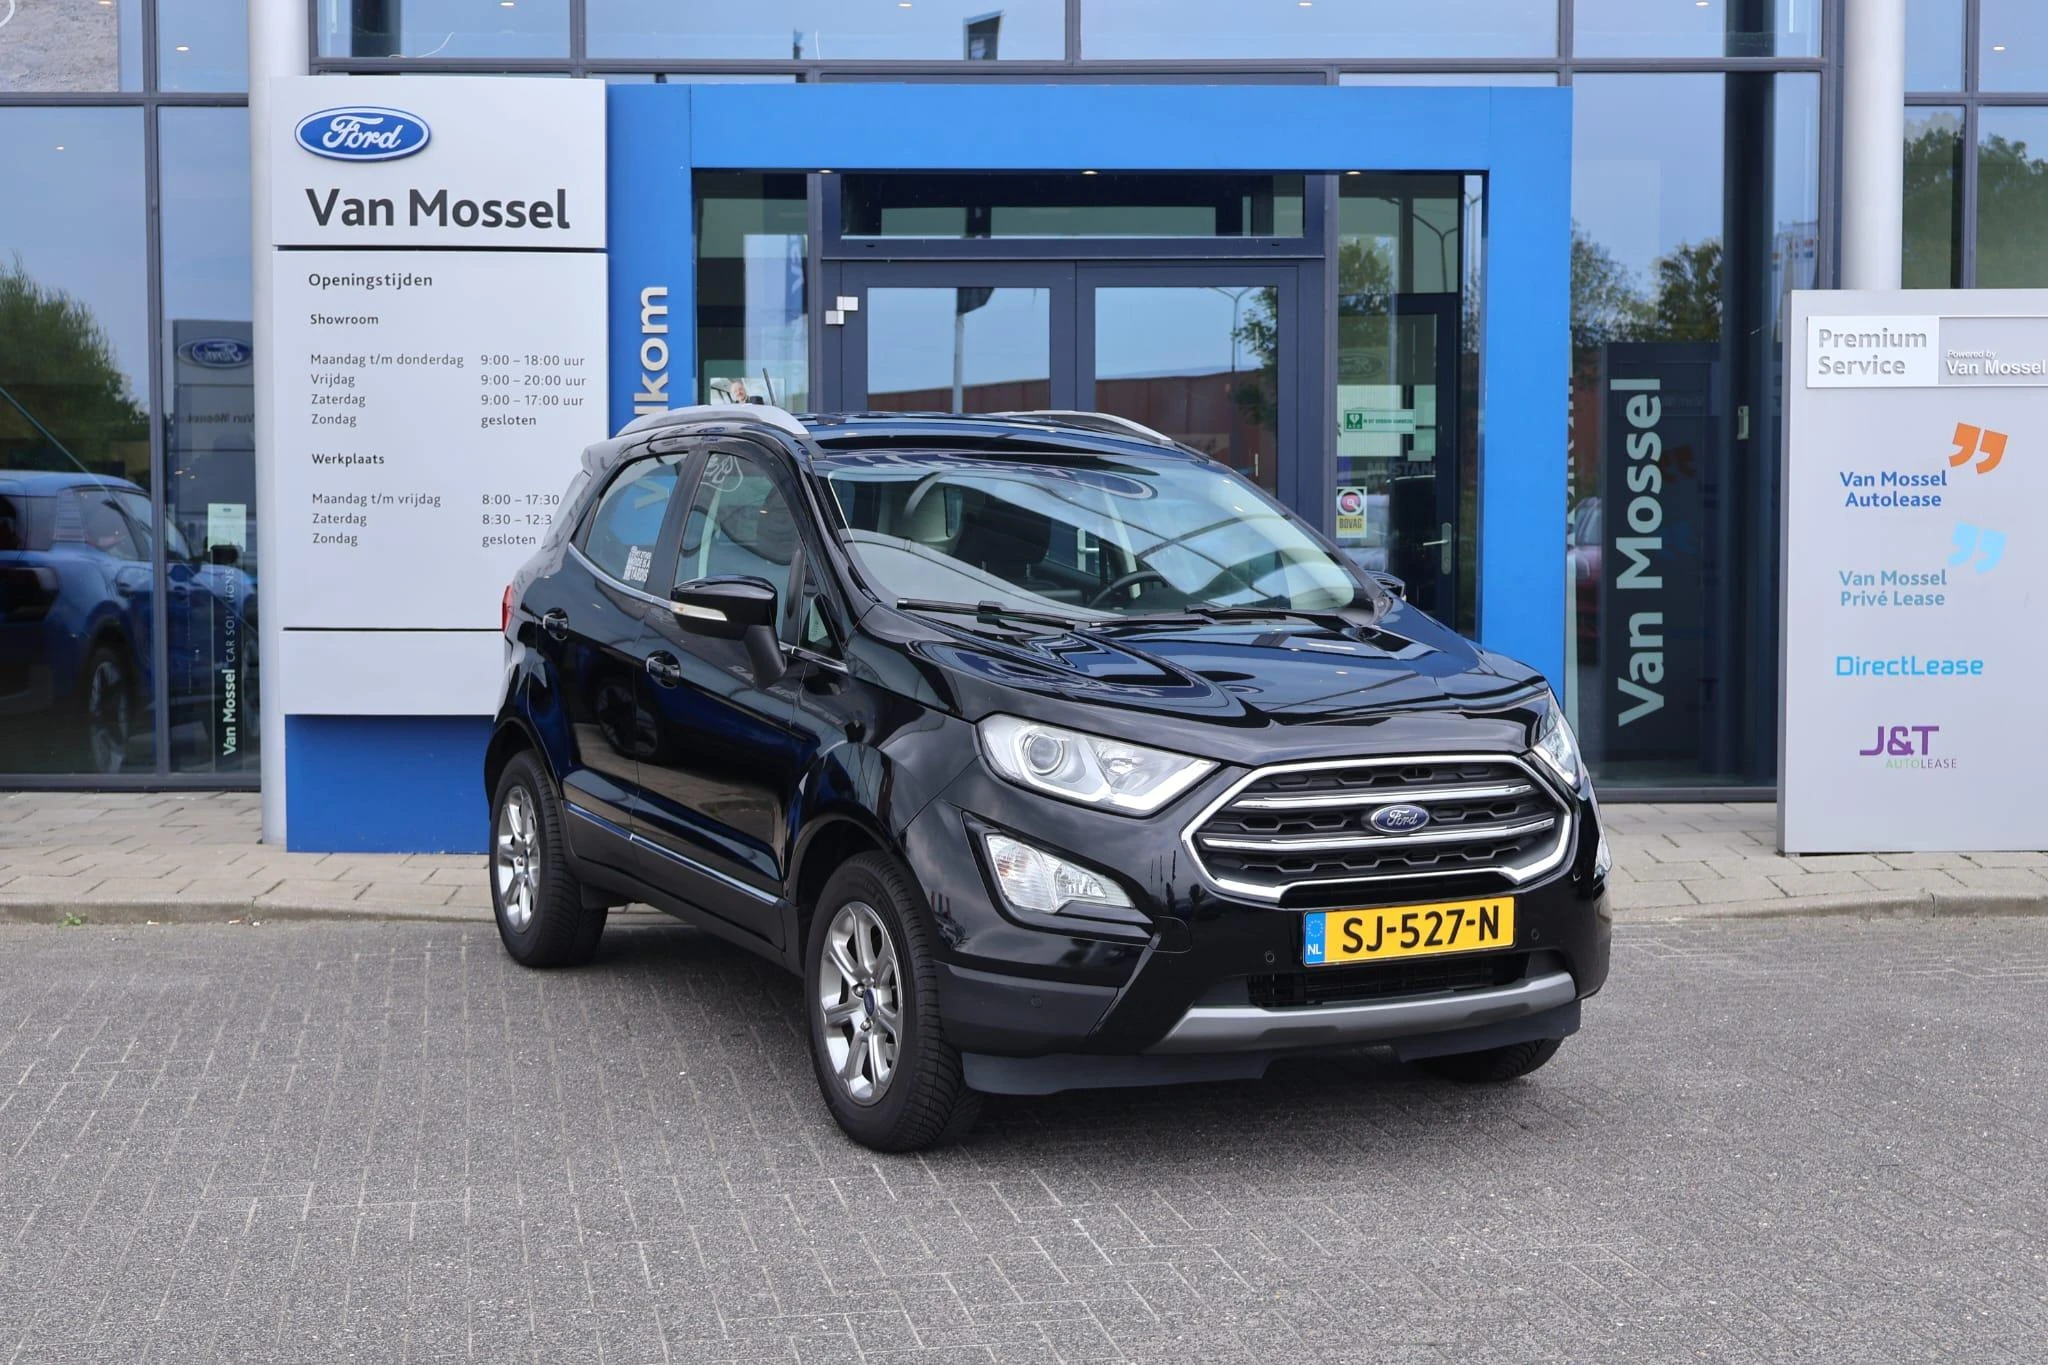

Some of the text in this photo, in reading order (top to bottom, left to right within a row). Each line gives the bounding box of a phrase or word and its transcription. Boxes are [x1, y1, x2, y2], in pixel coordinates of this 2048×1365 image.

[322, 115, 403, 149] Ford
[305, 188, 571, 229] Van Mossel
[308, 273, 433, 290] Openingstijden
[310, 313, 379, 326] Showroom
[1818, 327, 1927, 348] Premium
[634, 286, 670, 416] lkom
[1947, 349, 1997, 360] Powered by
[311, 353, 464, 369] Maandag t/m donderdag
[481, 354, 510, 366] 9:00
[524, 354, 560, 366] 18:00
[564, 357, 585, 367] uur
[1818, 354, 1906, 375] Service
[1946, 359, 2046, 376] Van Mossel
[311, 373, 355, 388] Vrijdag
[481, 375, 510, 386] 9:00
[524, 375, 562, 386] 20:00
[565, 377, 587, 387] uur
[311, 393, 366, 408] Zaterdag
[481, 394, 510, 406] 9:00
[525, 395, 560, 406] 17:00
[563, 397, 584, 407] uur
[312, 413, 357, 428] Zondag
[481, 414, 537, 429] gesloten
[312, 452, 385, 468] Werkplaats
[1839, 470, 1948, 488] Van Mossel
[312, 492, 442, 509] Maandag t/m vrijdag
[482, 494, 511, 505] 8:00
[525, 494, 560, 505] 17:30
[1844, 491, 1942, 507] Autolease
[312, 512, 367, 528] Zaterdag
[482, 514, 511, 525] 8:30
[526, 514, 552, 526] 12:3
[1339, 518, 1363, 530] BOVAG
[312, 532, 359, 548] Zondag
[482, 533, 537, 548] gesloten
[1609, 378, 1665, 727] Van Mossel
[1839, 569, 1947, 587] Van Mossel
[1840, 590, 1945, 607] Privé Lease
[225, 640, 236, 662] CAR
[1836, 656, 1984, 676] DirectLease
[222, 669, 236, 723] Mossel
[223, 725, 237, 756] Van
[1859, 725, 1940, 757] J&T
[1886, 758, 1957, 769] AUTOLEASE
[1386, 809, 1418, 827] Ford
[1307, 905, 1499, 956] NL SJ-527-N
